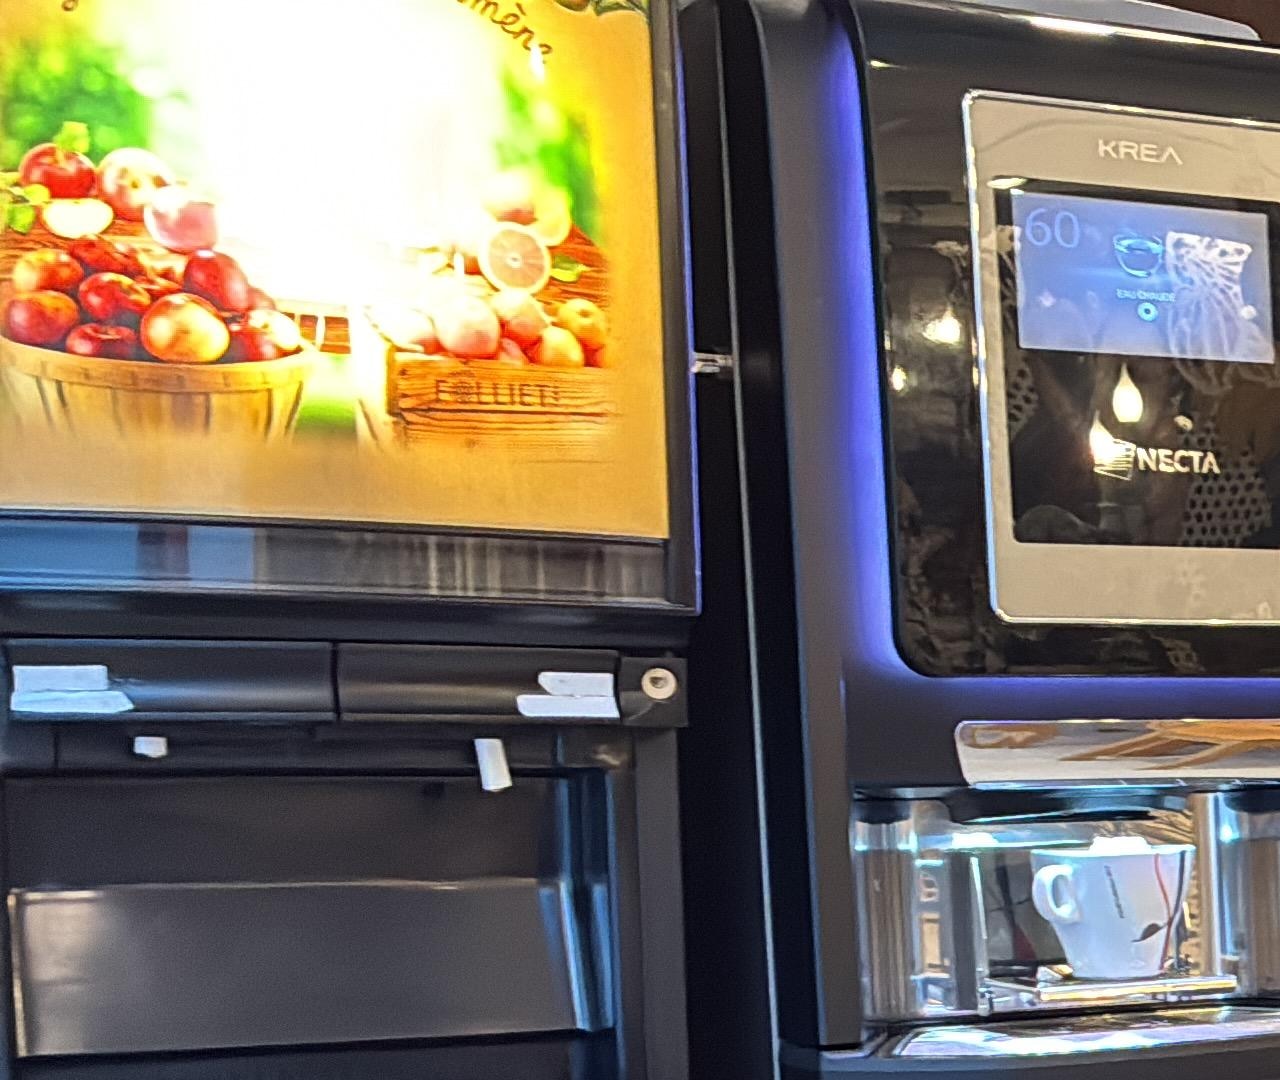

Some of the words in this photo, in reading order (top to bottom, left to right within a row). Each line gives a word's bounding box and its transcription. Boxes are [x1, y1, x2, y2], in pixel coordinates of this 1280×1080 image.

[1098, 139, 1184, 166] KREA
[1025, 207, 1081, 249] 60
[1136, 447, 1221, 474] NECTA
